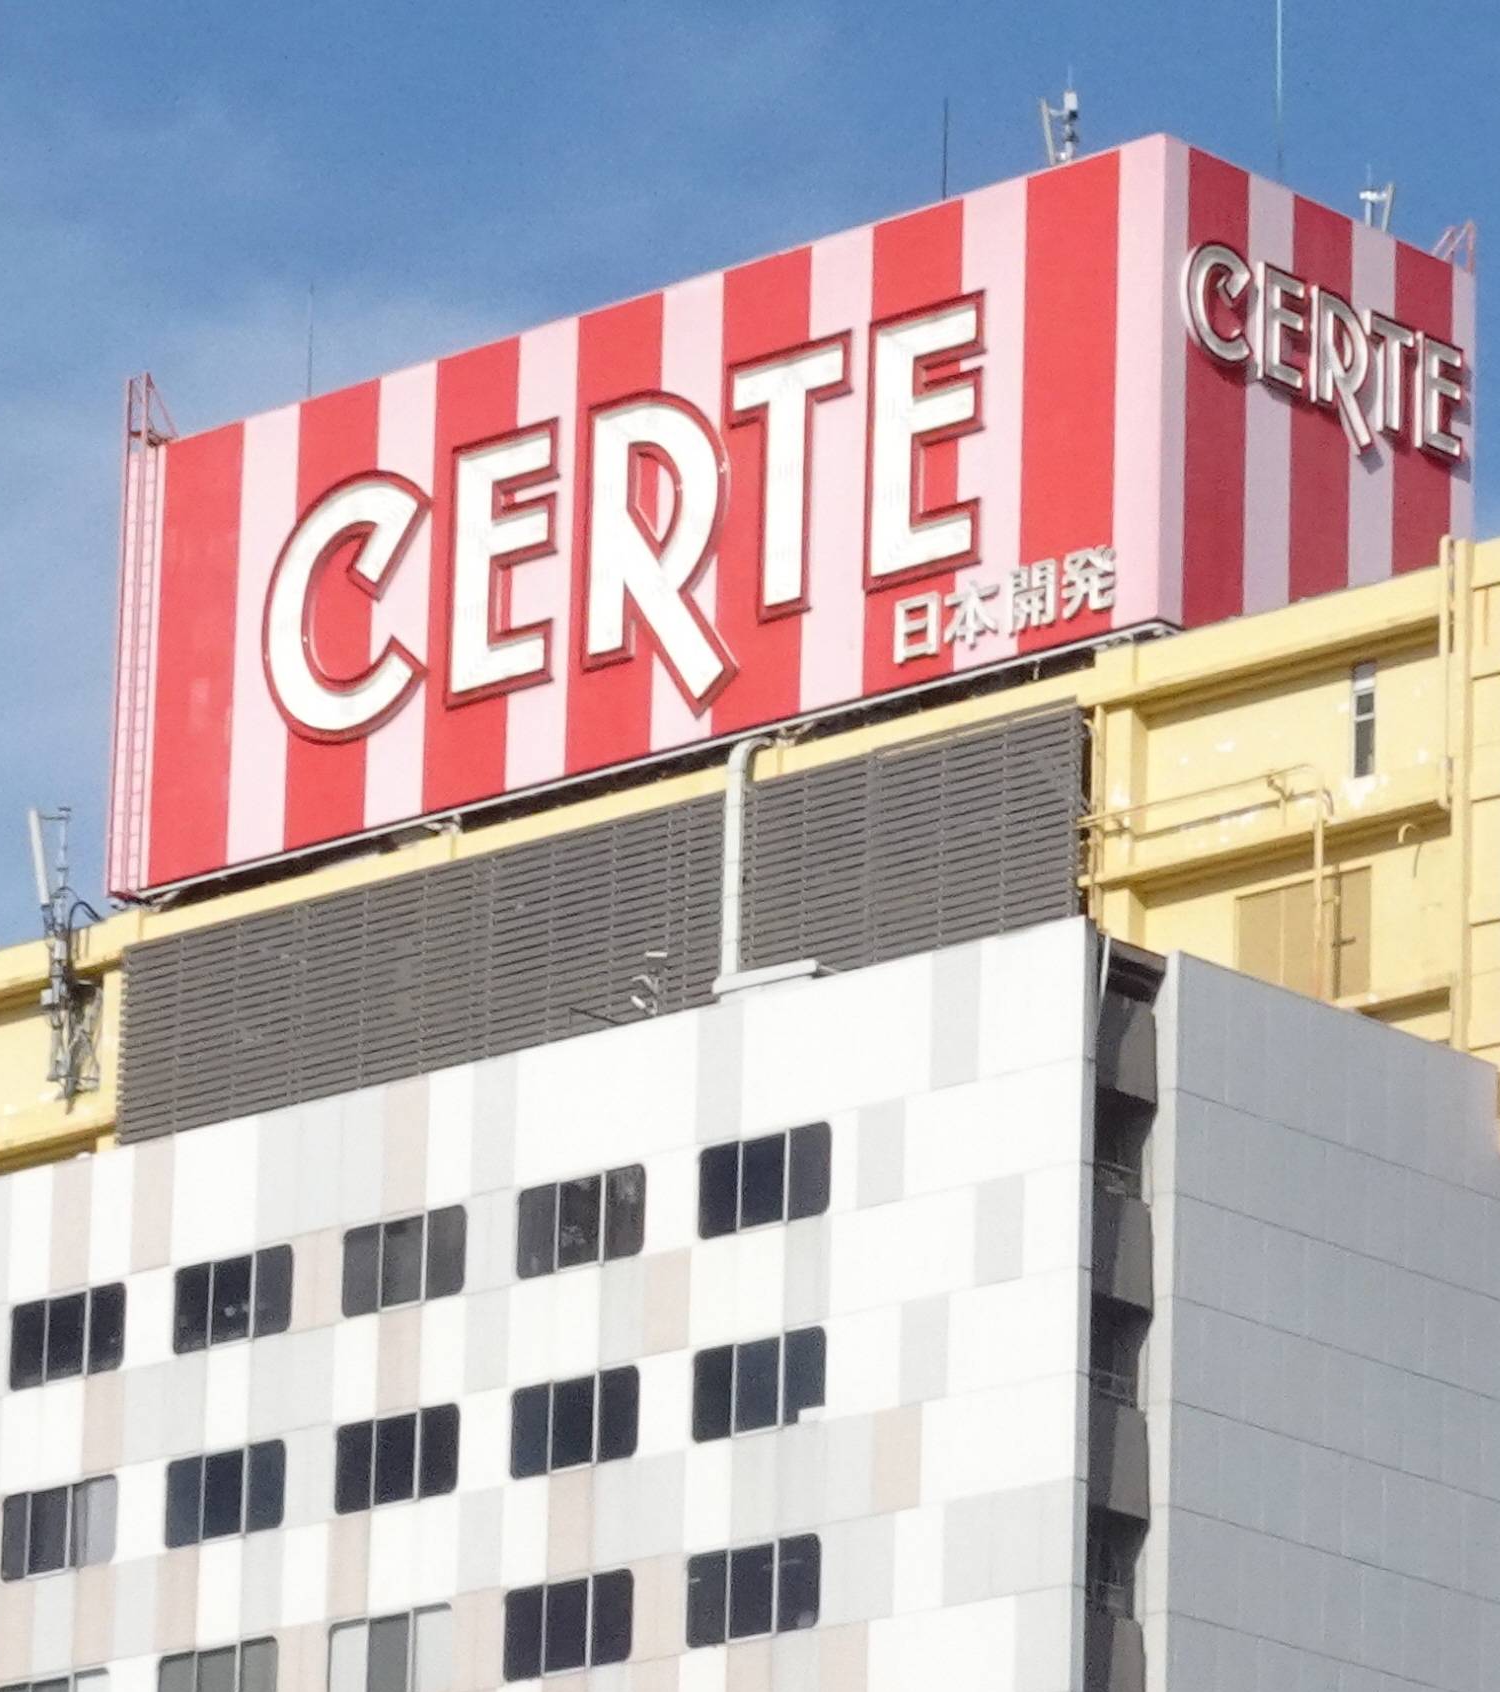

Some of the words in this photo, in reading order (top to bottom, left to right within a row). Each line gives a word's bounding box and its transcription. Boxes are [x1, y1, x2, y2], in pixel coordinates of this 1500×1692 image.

[1181, 241, 1463, 459] CERTE
[263, 290, 986, 744] CERTE
[893, 544, 1117, 664] 日本開発
